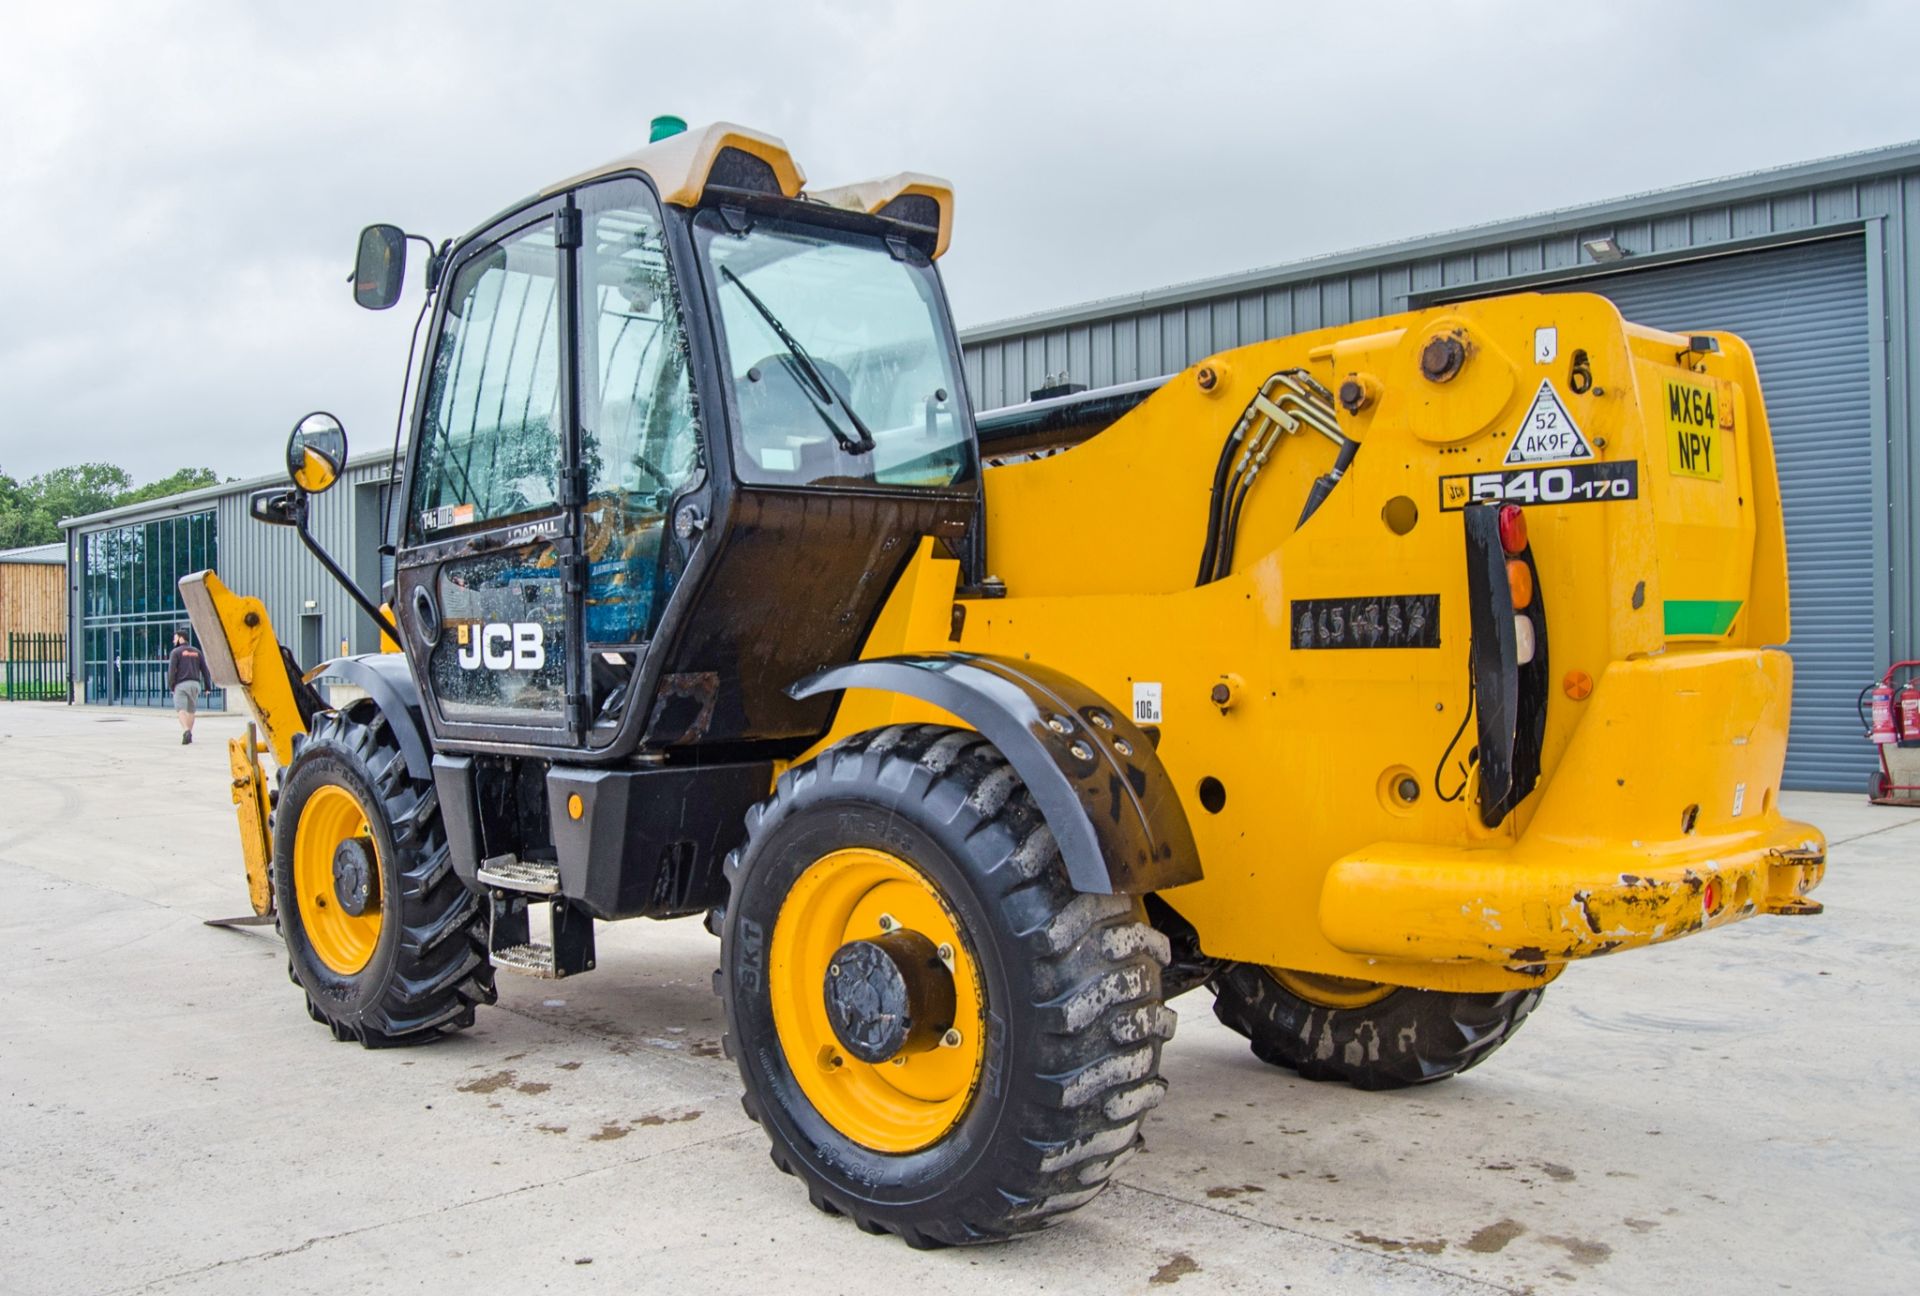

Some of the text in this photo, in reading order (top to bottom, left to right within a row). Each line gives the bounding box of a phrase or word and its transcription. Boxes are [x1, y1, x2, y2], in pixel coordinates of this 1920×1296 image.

[1535, 412, 1558, 430] 52
[1668, 382, 1715, 429] MX64
[1526, 432, 1571, 453] AK9F
[1678, 431, 1713, 473] NPY
[457, 622, 546, 671] JCB
[1135, 700, 1152, 719] 106
[741, 918, 762, 991] BKT
